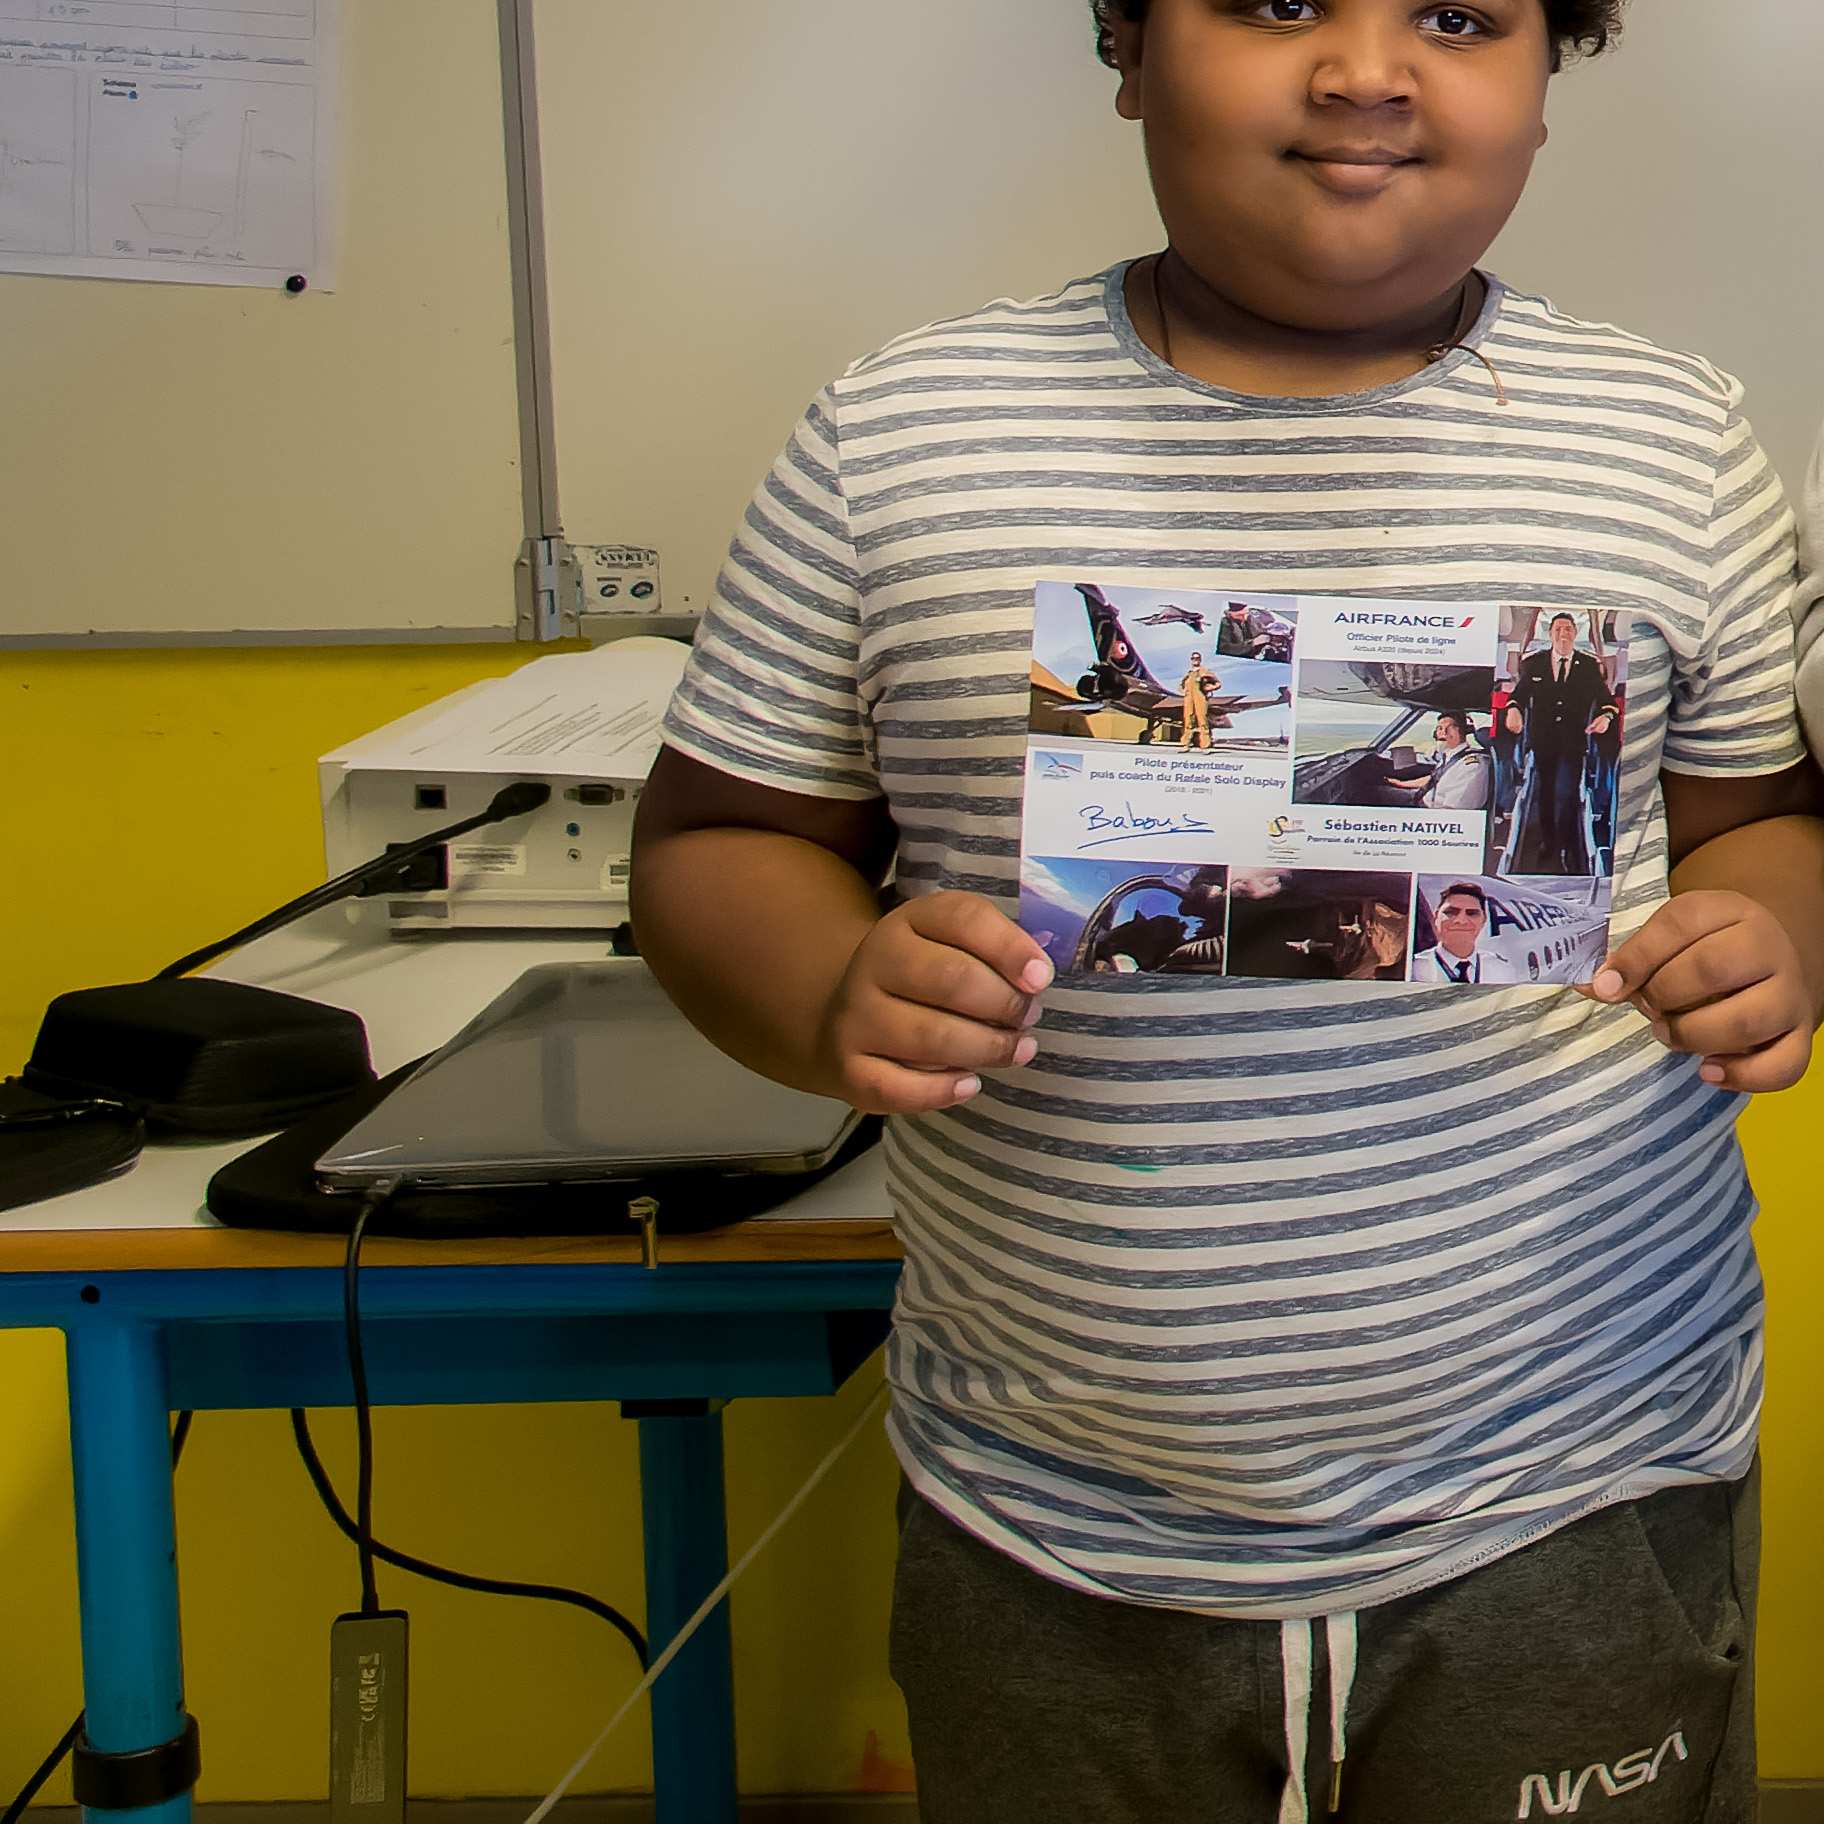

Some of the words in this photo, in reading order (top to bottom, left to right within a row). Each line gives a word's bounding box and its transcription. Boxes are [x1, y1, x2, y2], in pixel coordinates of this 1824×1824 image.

[1334, 612, 1455, 628] AIRFRANCE
[1134, 757, 1168, 769] Pilote
[1089, 771, 1115, 781] puis
[1117, 770, 1154, 782] coach
[1157, 771, 1172, 782] du
[1214, 774, 1240, 785] Solo
[1243, 776, 1286, 789] Display
[1324, 818, 1398, 833] Sébastien
[1401, 822, 1465, 834] NATIVEL
[1516, 1731, 1688, 1820] NASA
